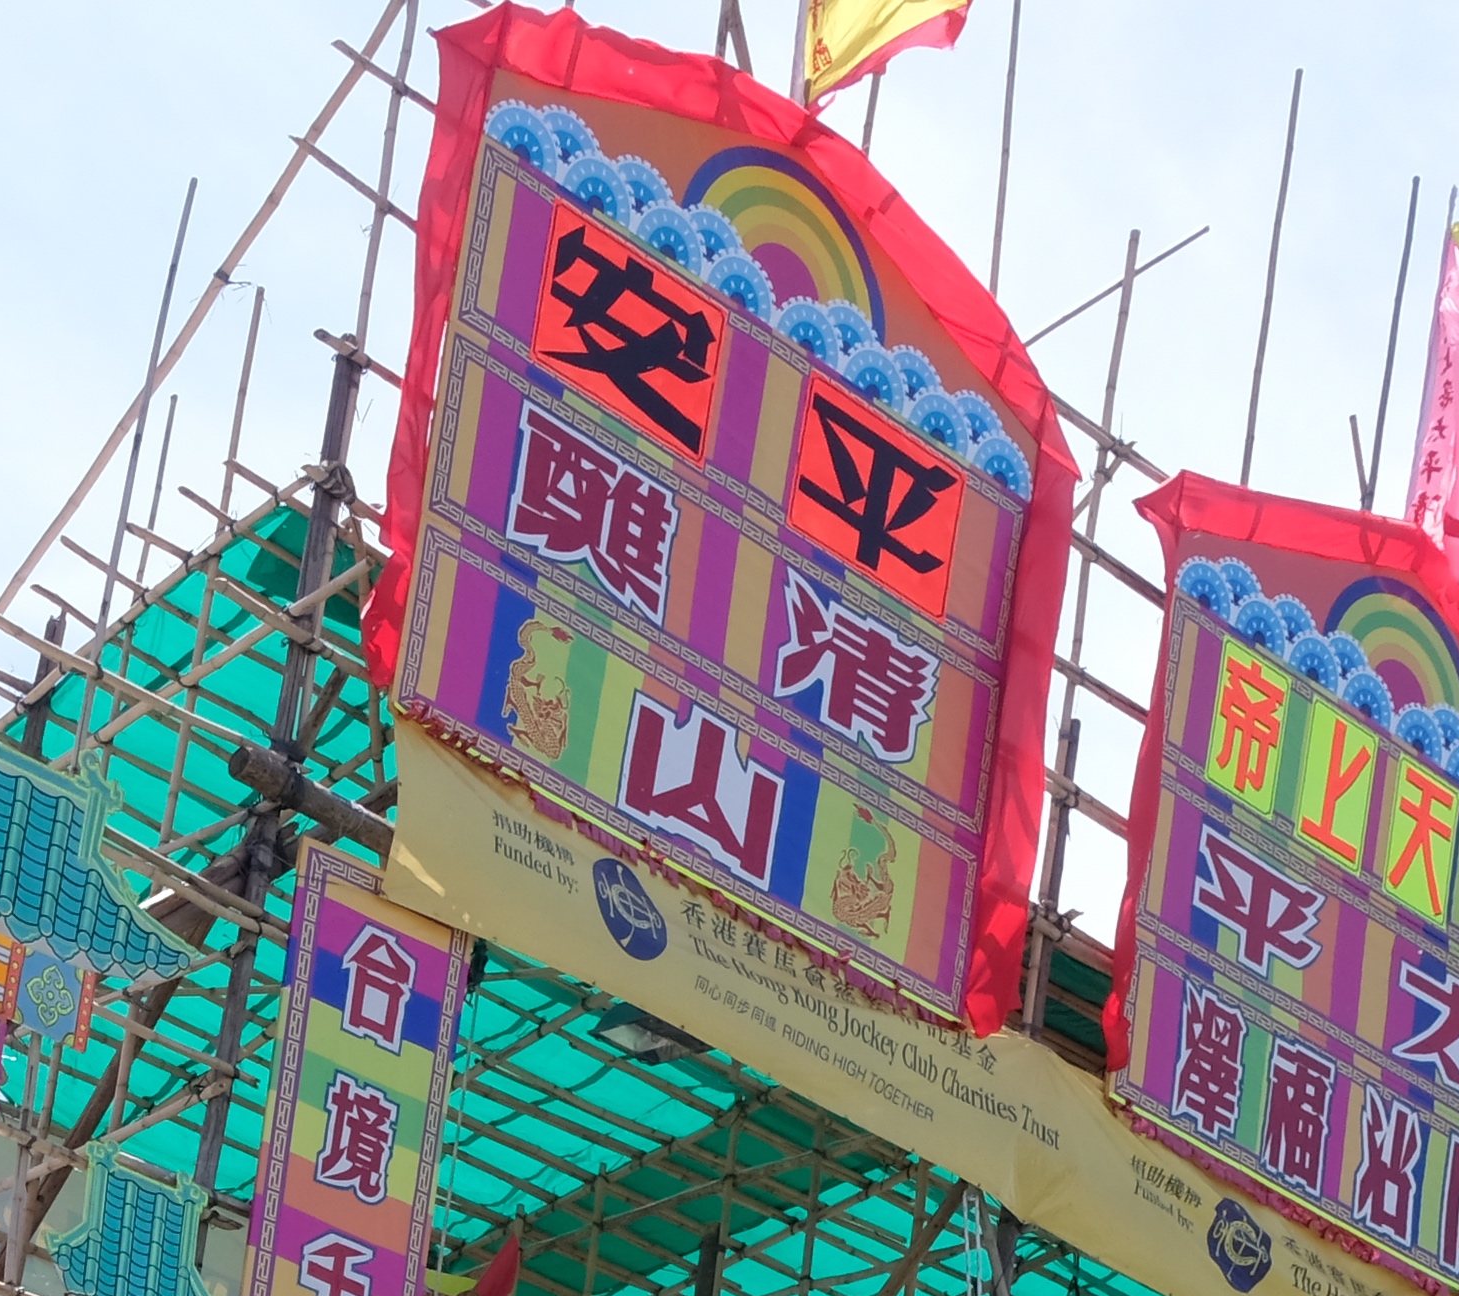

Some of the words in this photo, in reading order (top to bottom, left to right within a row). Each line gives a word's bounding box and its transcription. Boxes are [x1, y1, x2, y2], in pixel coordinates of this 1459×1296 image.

[492, 835, 554, 883] Funded
[555, 867, 579, 895] by:
[618, 689, 787, 893] 山
[688, 933, 735, 970] The
[735, 951, 790, 1004] Hong
[789, 985, 840, 1038] Kong
[841, 1010, 899, 1068] Jockey
[900, 1039, 940, 1084] Club
[940, 1063, 1019, 1124] Charities
[1019, 1103, 1061, 1152] Trust
[782, 1021, 831, 1064] RIDING
[831, 1049, 868, 1081] HIGH
[867, 1070, 936, 1124] TOGETHER
